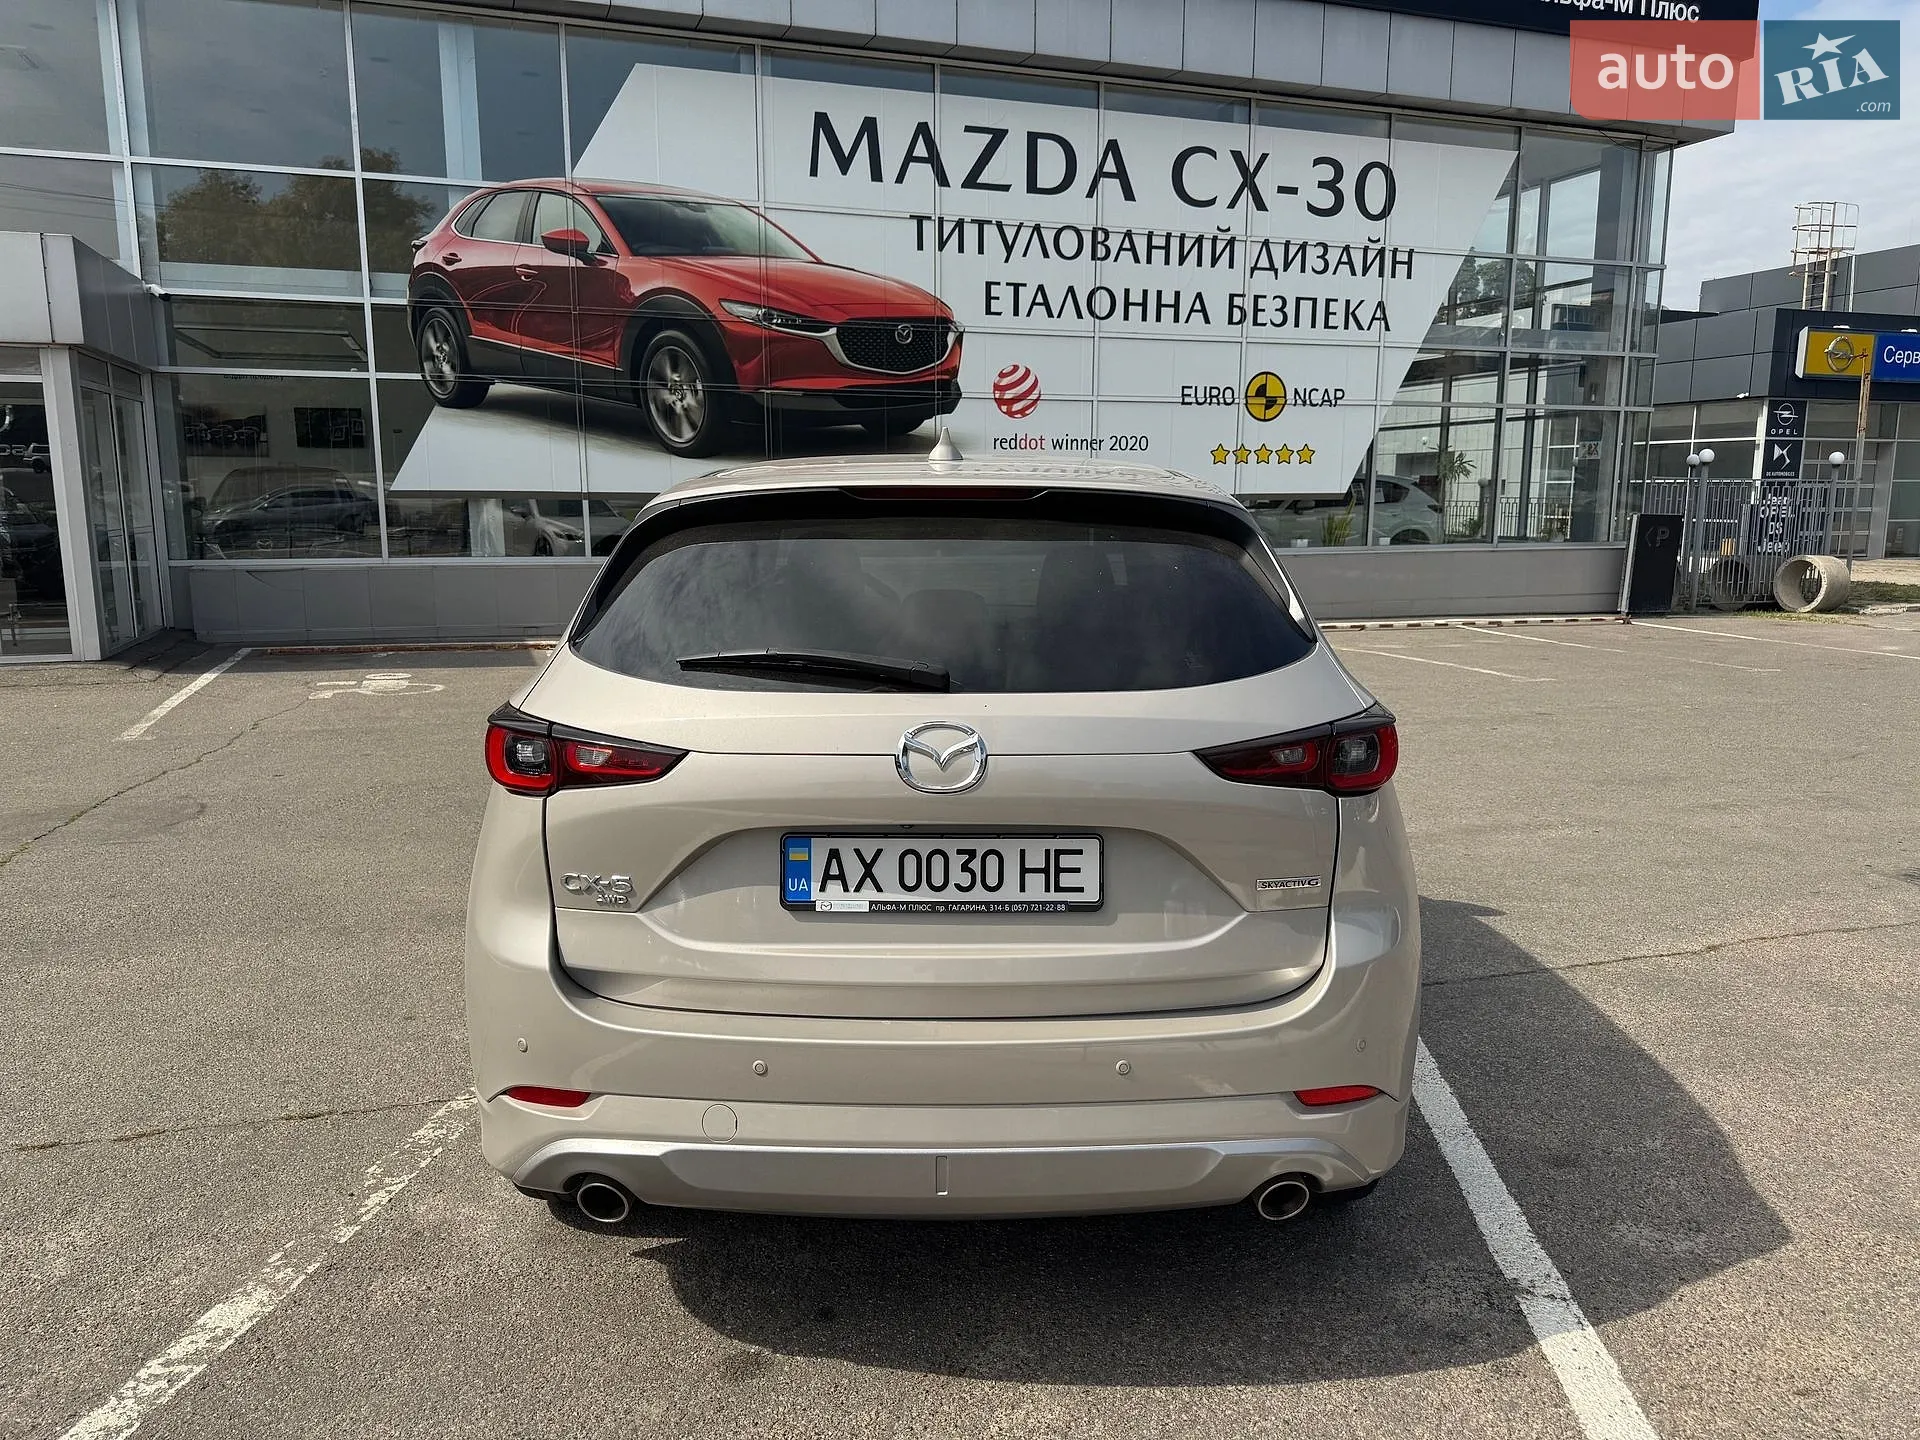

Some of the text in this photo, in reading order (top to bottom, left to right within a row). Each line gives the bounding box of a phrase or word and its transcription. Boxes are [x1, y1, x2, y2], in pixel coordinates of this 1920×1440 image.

[809, 111, 1397, 222] MAZDA CX-30
[908, 214, 1414, 281] ТИТУЛОВАНИЙ ДИЗАЙН
[984, 281, 1391, 332] ЕТАЛОННА БЕЗПЕКА
[1181, 386, 1345, 408] EURO NCAP
[993, 434, 1149, 452] reddot winner 2020
[1769, 522, 1783, 534] DS
[818, 848, 1085, 893] AX 0030 HE
[560, 873, 633, 893] CX-5
[789, 878, 808, 891] UA
[596, 894, 628, 905] AWD
[935, 905, 947, 913] пр.
[1011, 904, 1029, 913] (057)
[1030, 904, 1066, 912] 721-22-88
